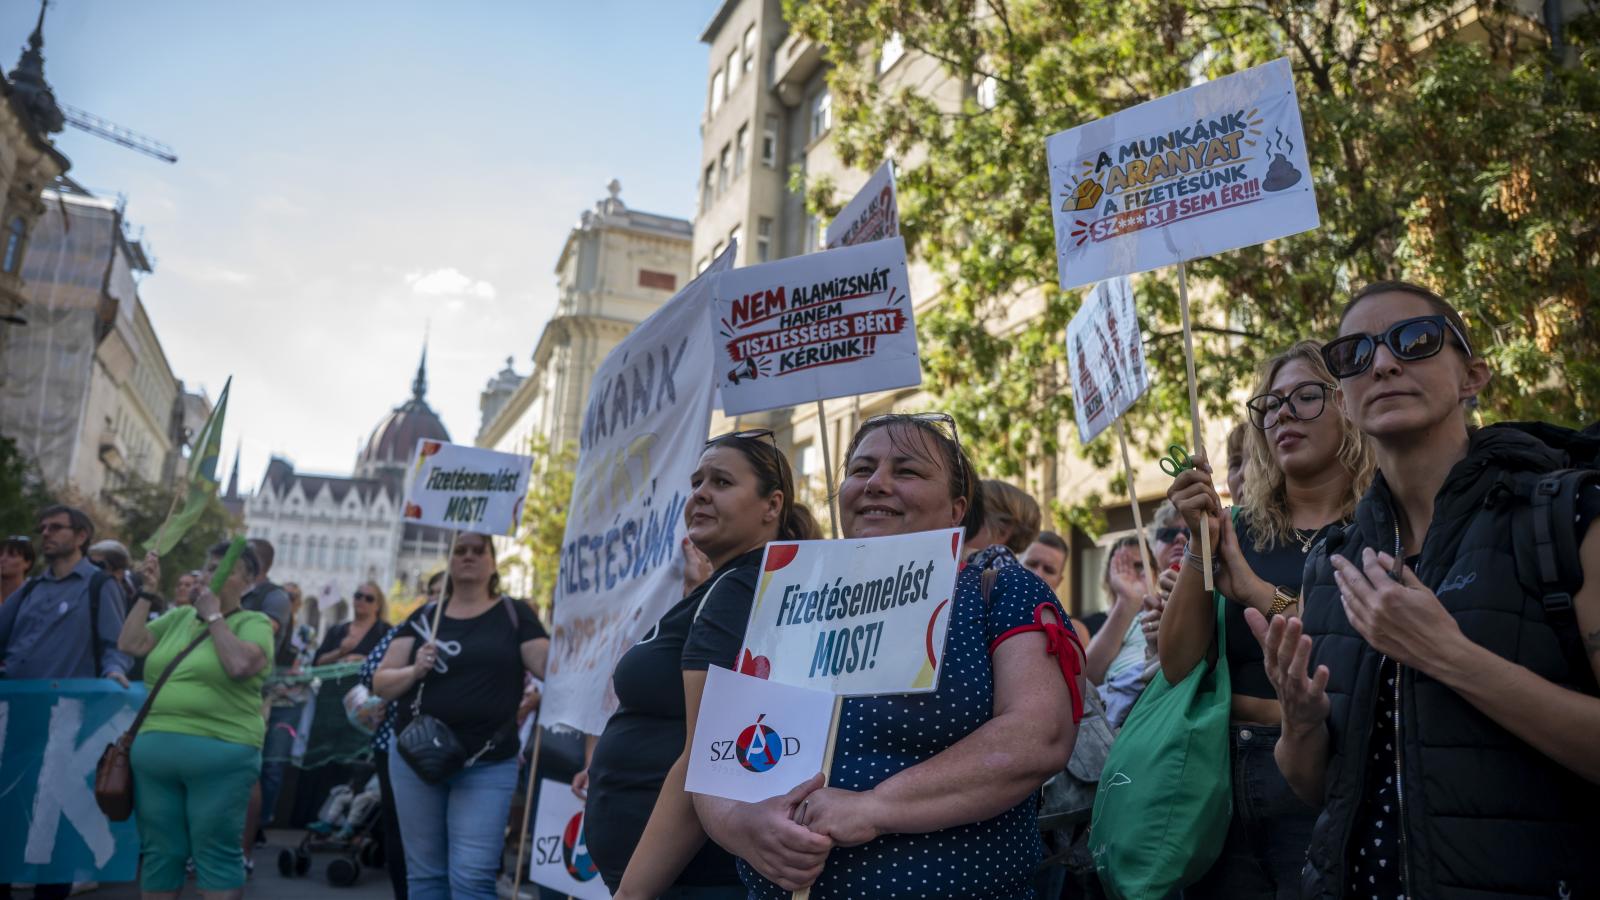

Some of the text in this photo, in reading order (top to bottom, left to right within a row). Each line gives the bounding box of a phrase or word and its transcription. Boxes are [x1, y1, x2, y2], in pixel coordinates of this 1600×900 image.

[1095, 110, 1247, 173] A MUNKÁNK
[1105, 130, 1244, 194] ARANYAT
[1103, 164, 1247, 216] A FIZETÉSÜNK
[1180, 192, 1217, 216] SEM
[1222, 178, 1260, 206] ÉR!!!
[731, 286, 787, 327] NEM
[780, 303, 842, 328] HANEM
[737, 311, 897, 360] TISZTESSÉGES BÉRT
[780, 336, 876, 372] KÉRÜNK!!
[426, 467, 520, 493] Fizetésemelést
[443, 496, 488, 522] MOST!
[776, 560, 935, 627] Fizetésemelést
[809, 620, 885, 678] MOST!
[710, 713, 801, 773] SZÁD
